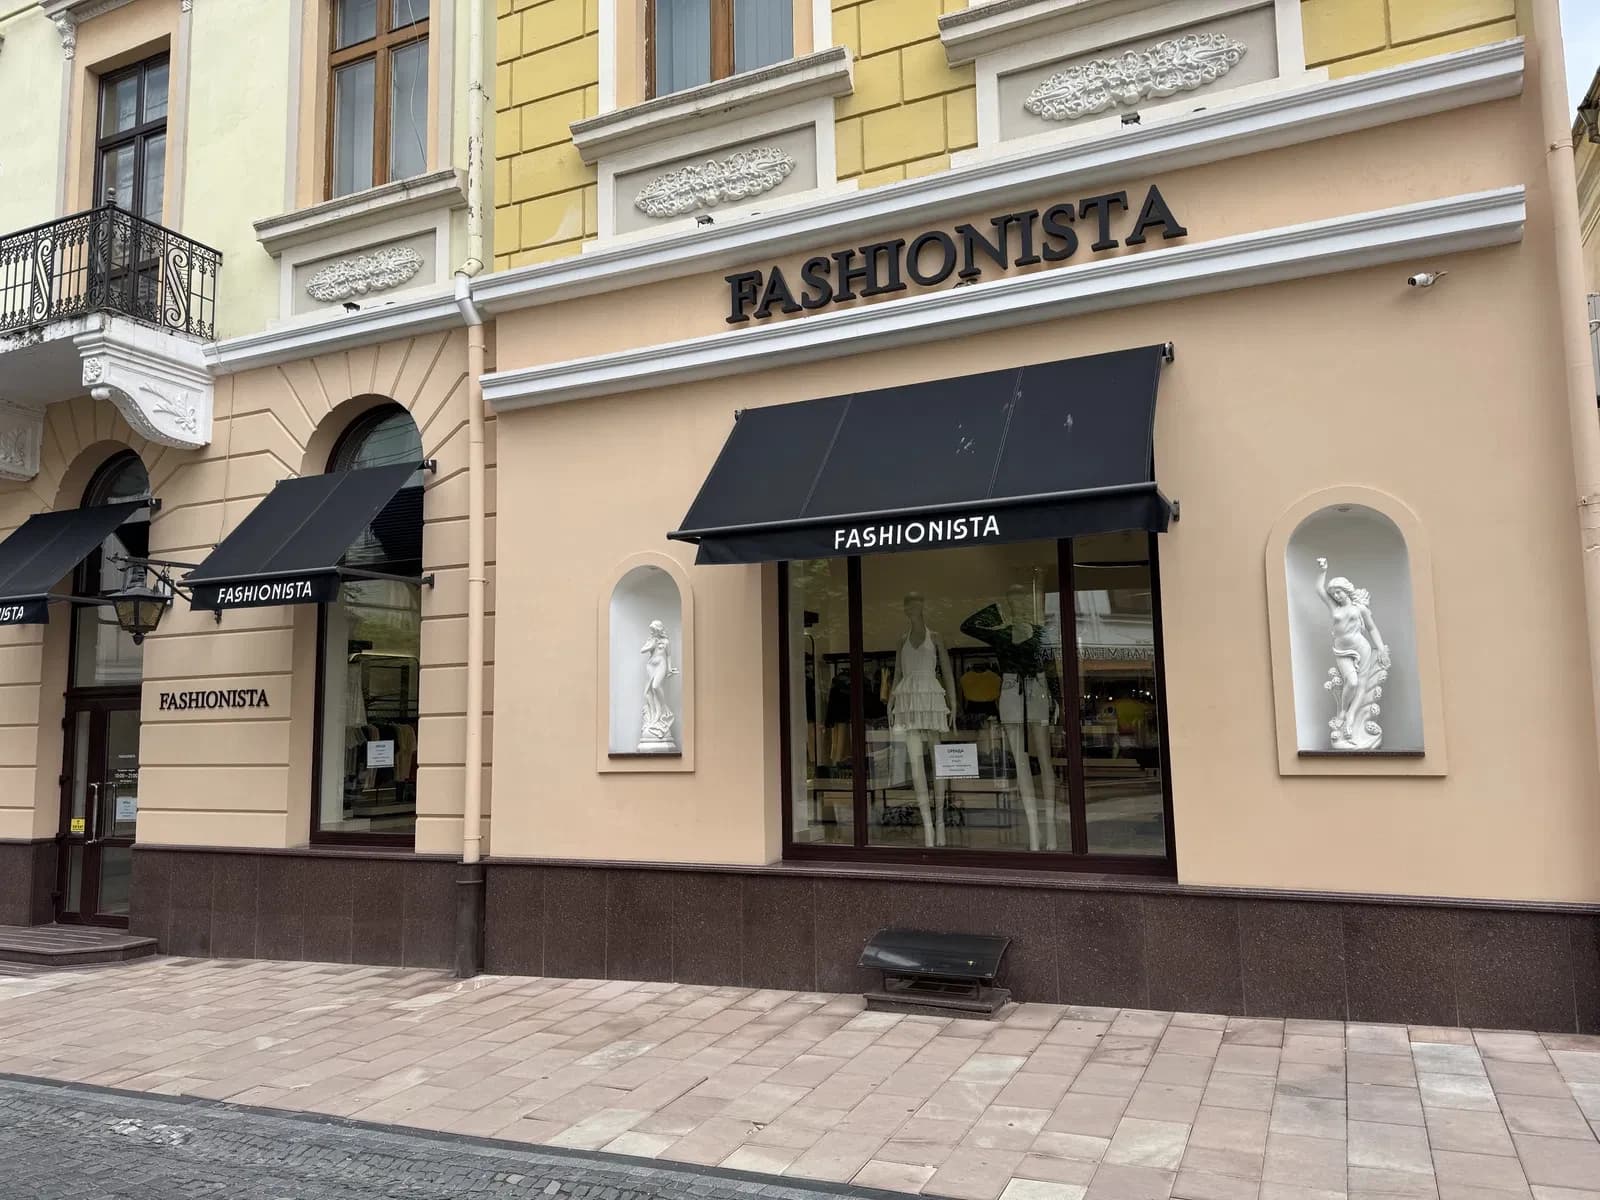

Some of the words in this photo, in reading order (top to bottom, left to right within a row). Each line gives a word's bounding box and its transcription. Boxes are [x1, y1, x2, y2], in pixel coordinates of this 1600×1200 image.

[725, 184, 1188, 323] FASHIONISTA
[833, 515, 1001, 551] FASHIONISTA
[217, 580, 313, 604] FASHIONISTA
[160, 689, 268, 711] FASHIONISTA
